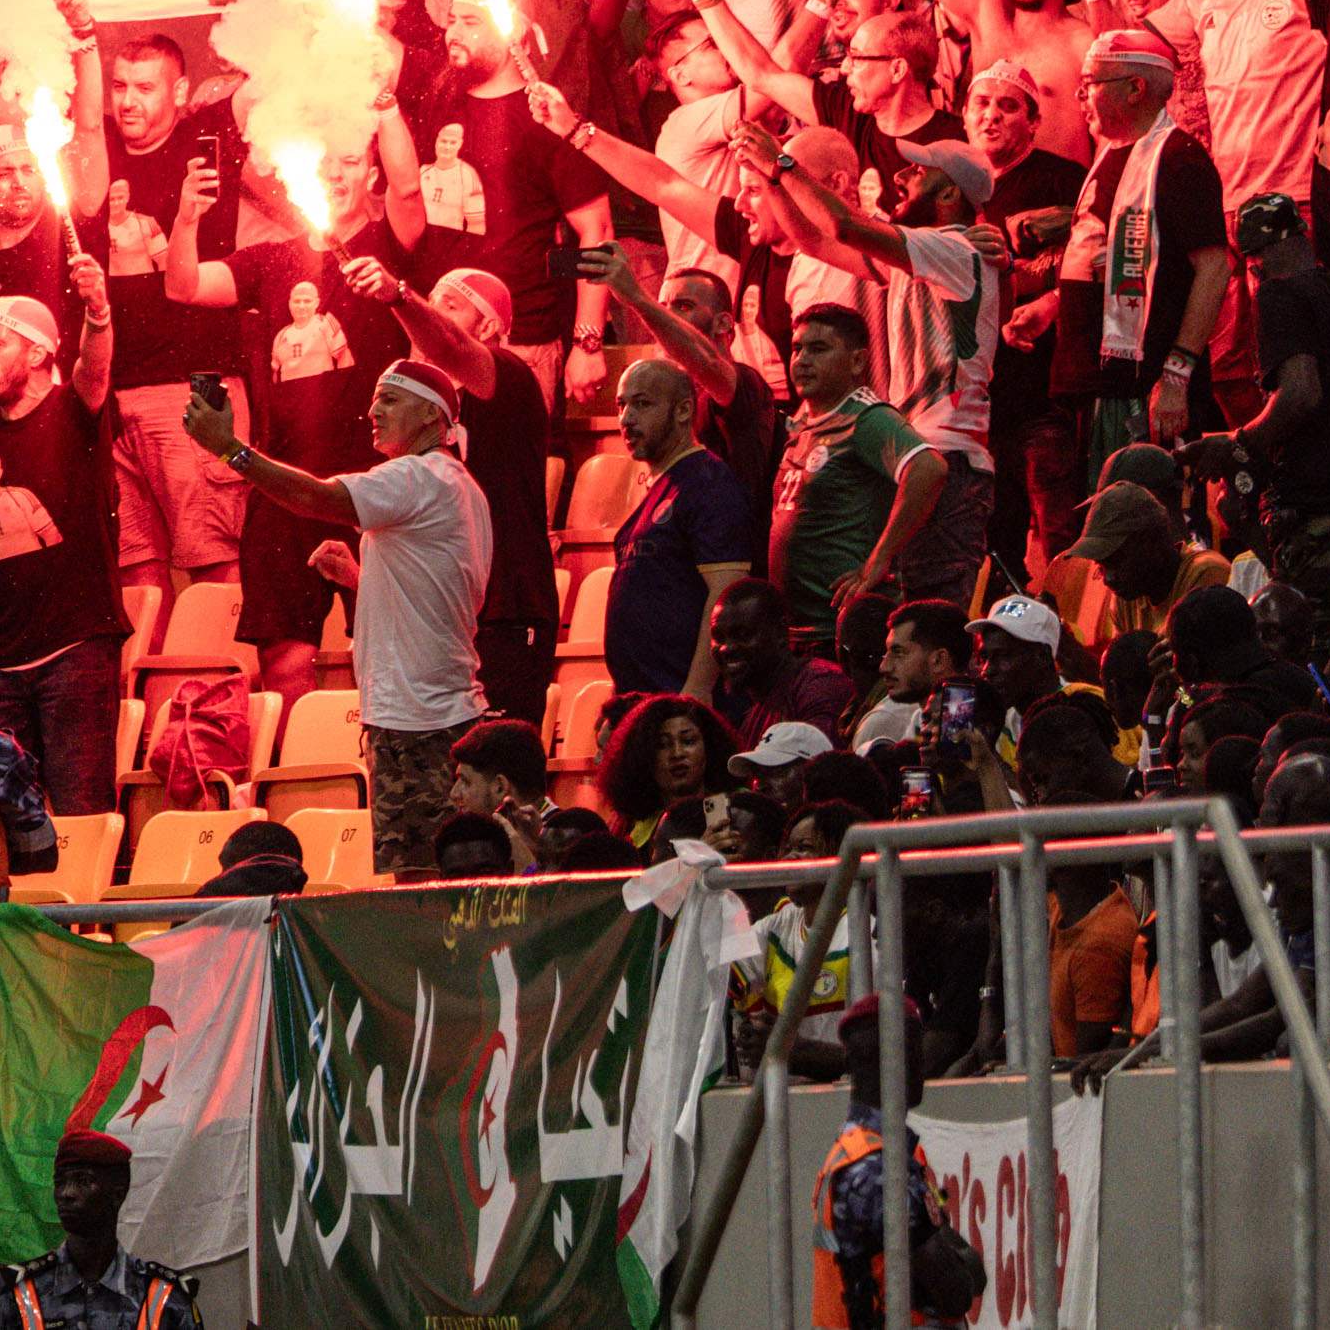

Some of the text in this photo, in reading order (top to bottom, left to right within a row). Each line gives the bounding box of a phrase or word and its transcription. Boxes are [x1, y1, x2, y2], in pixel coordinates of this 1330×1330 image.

[1122, 208, 1147, 279] ALGERIA
[775, 469, 802, 511] 22
[199, 830, 214, 845] 06
[341, 828, 357, 842] 07
[272, 967, 436, 1272] الجزائر
